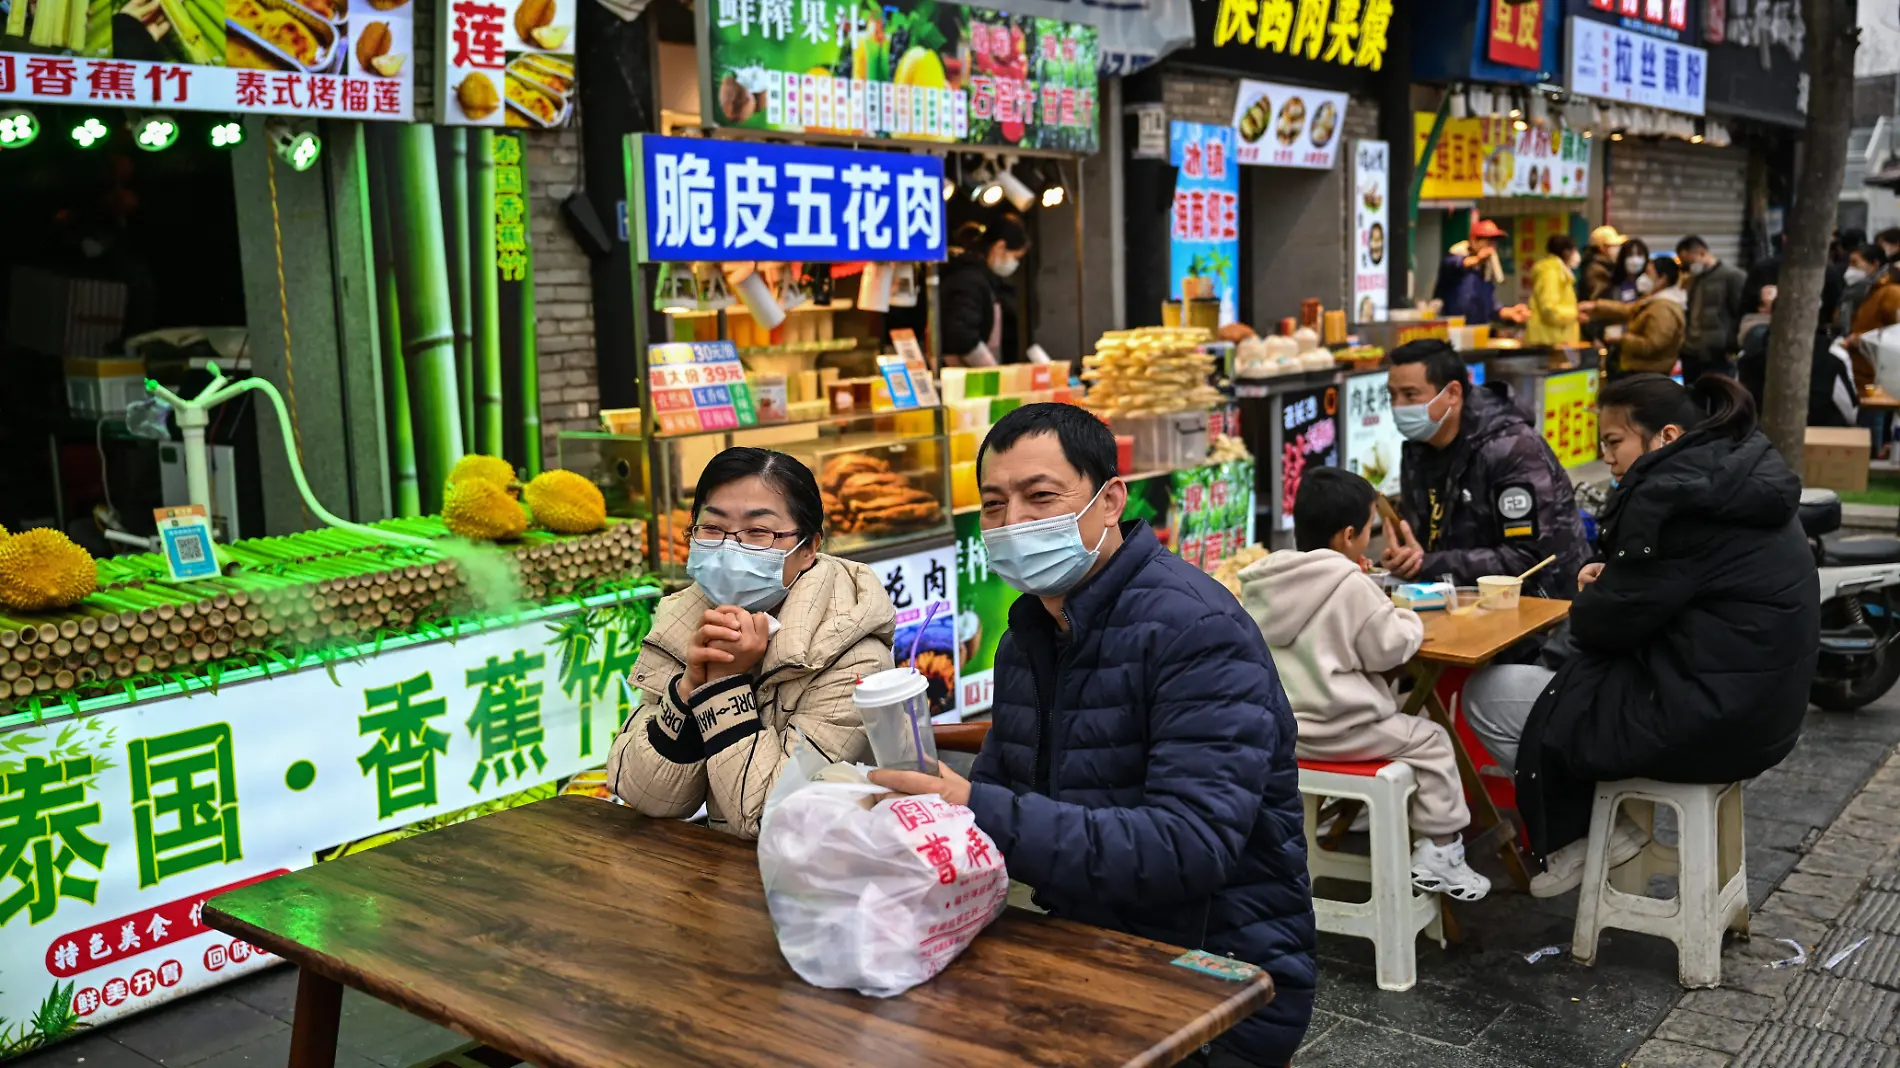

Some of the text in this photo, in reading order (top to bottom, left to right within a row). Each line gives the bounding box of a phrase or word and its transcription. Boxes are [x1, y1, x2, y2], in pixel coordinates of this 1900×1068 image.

[452, 0, 506, 71] 莲
[235, 69, 402, 114] 泰式烤榴莲
[654, 152, 942, 250] 脆皮五花肉
[54, 912, 173, 970] 特色美食
[74, 961, 181, 1015] 鲜美开胃
